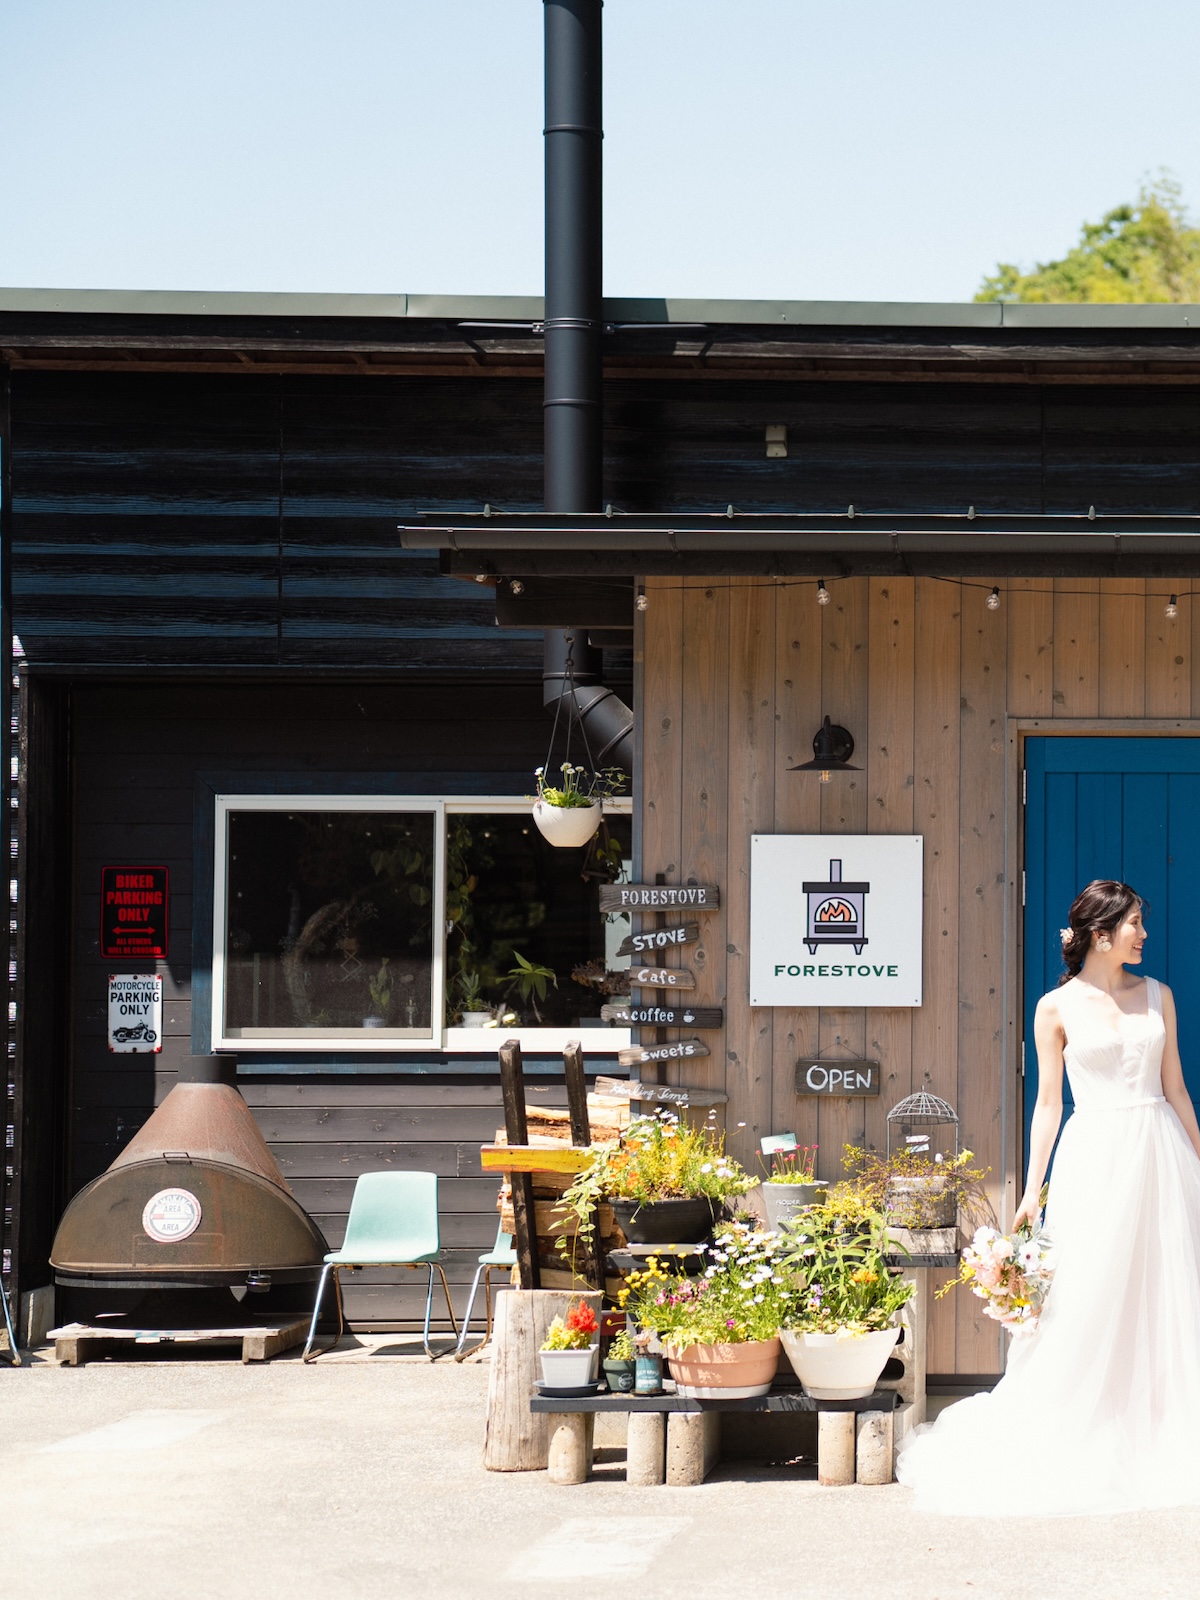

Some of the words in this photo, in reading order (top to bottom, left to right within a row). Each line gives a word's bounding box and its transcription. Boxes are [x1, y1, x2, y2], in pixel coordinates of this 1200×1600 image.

[115, 874, 154, 889] BIKER
[106, 890, 163, 905] PARKING
[621, 888, 707, 906] FORESTOVE
[117, 907, 151, 922] ONLY
[116, 937, 127, 945] ALL
[128, 937, 152, 945] OTHERS
[632, 928, 687, 952] STOVE
[107, 946, 122, 954] WILL
[123, 946, 131, 954] BE
[132, 946, 162, 954] CRUSHED
[637, 968, 677, 985] Cafe
[774, 965, 899, 977] FORESTOVE
[110, 981, 160, 991] MOTORCYCLE
[110, 992, 160, 1003] PARKING
[120, 1004, 150, 1015] ONLY
[631, 1007, 675, 1022] coffee
[641, 1043, 695, 1061] sweets
[806, 1065, 872, 1092] OPEN
[609, 1082, 656, 1100] Healing
[657, 1087, 690, 1101] Time
[155, 1194, 192, 1206] SMOKING
[161, 1223, 179, 1231] AREA
